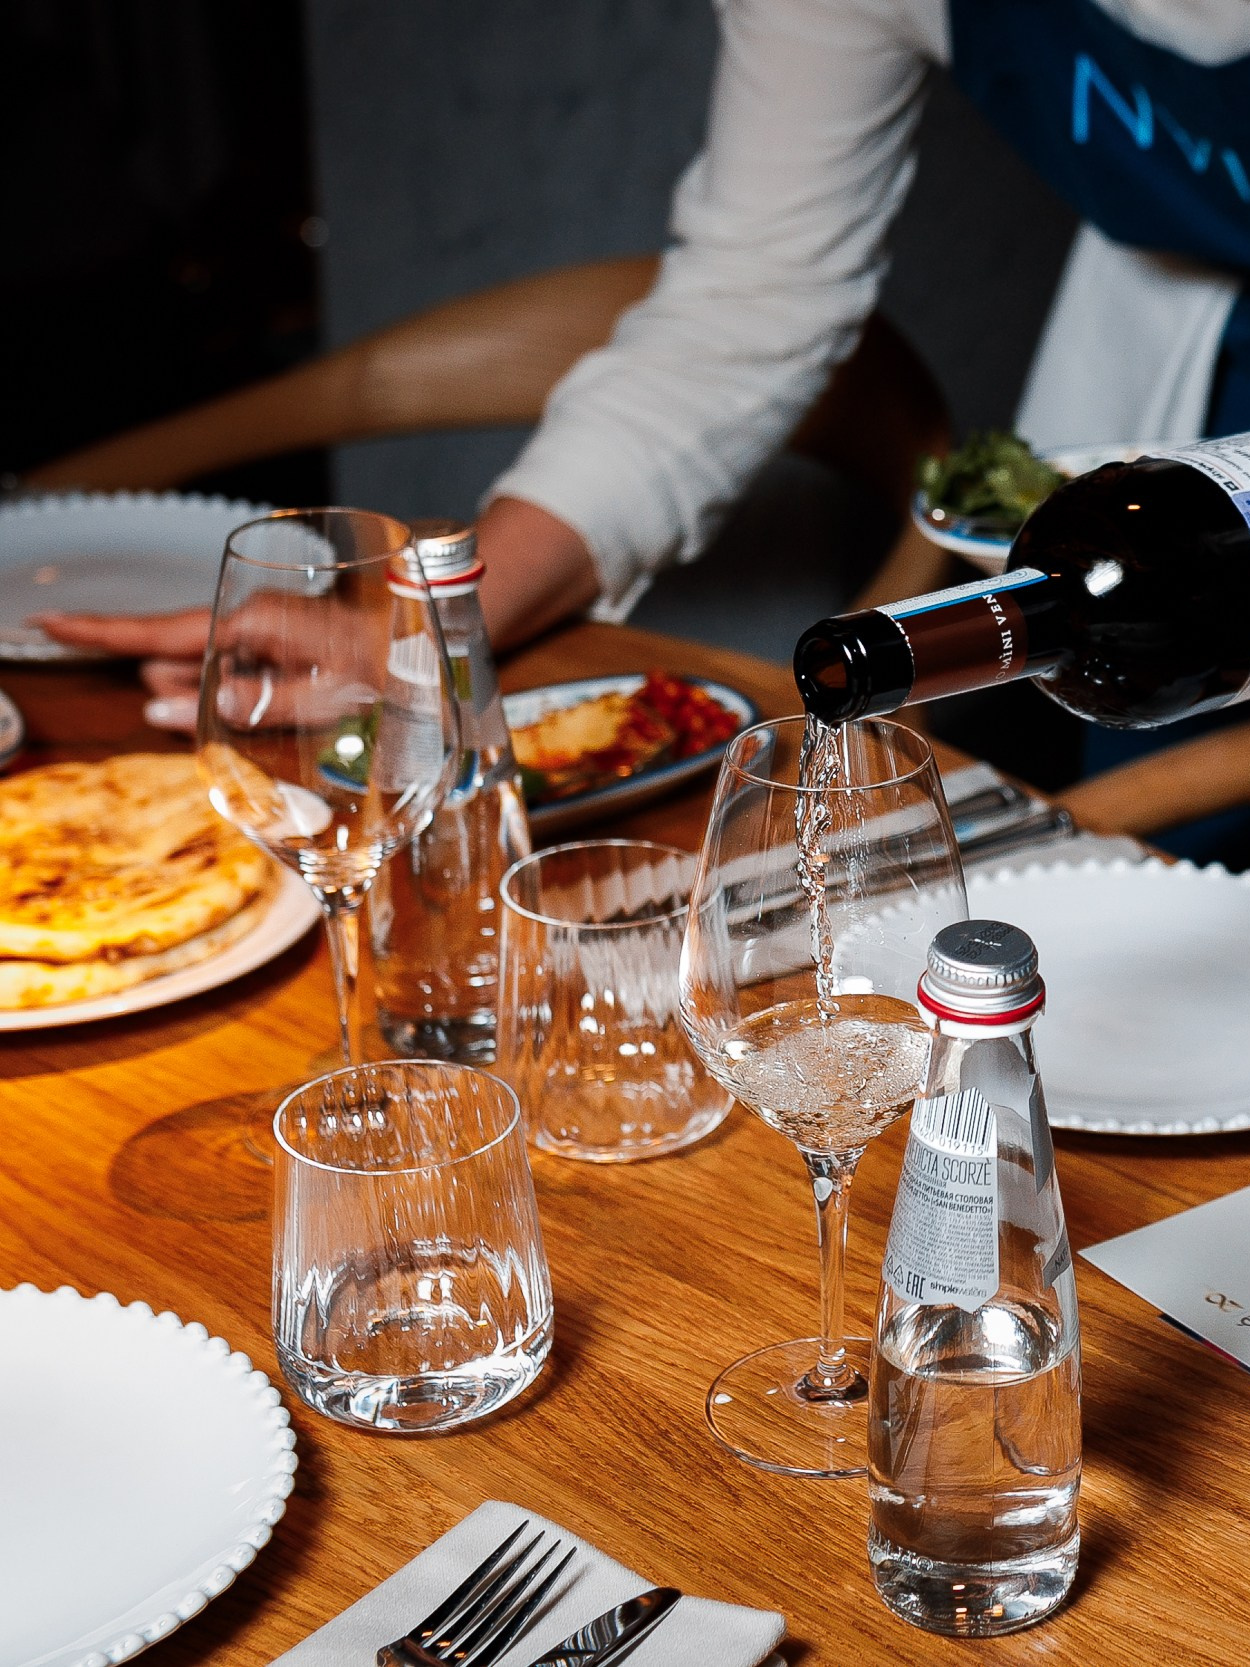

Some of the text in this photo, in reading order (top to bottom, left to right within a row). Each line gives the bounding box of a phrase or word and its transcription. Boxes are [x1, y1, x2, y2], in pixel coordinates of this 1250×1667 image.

[982, 594, 1013, 680] OMÌNI VEN
[908, 1137, 938, 1178] EDICTA
[942, 1156, 992, 1186] SCORZÈ
[939, 1135, 984, 1156] 019115
[954, 1194, 994, 1205] СТОЛОВАЯ
